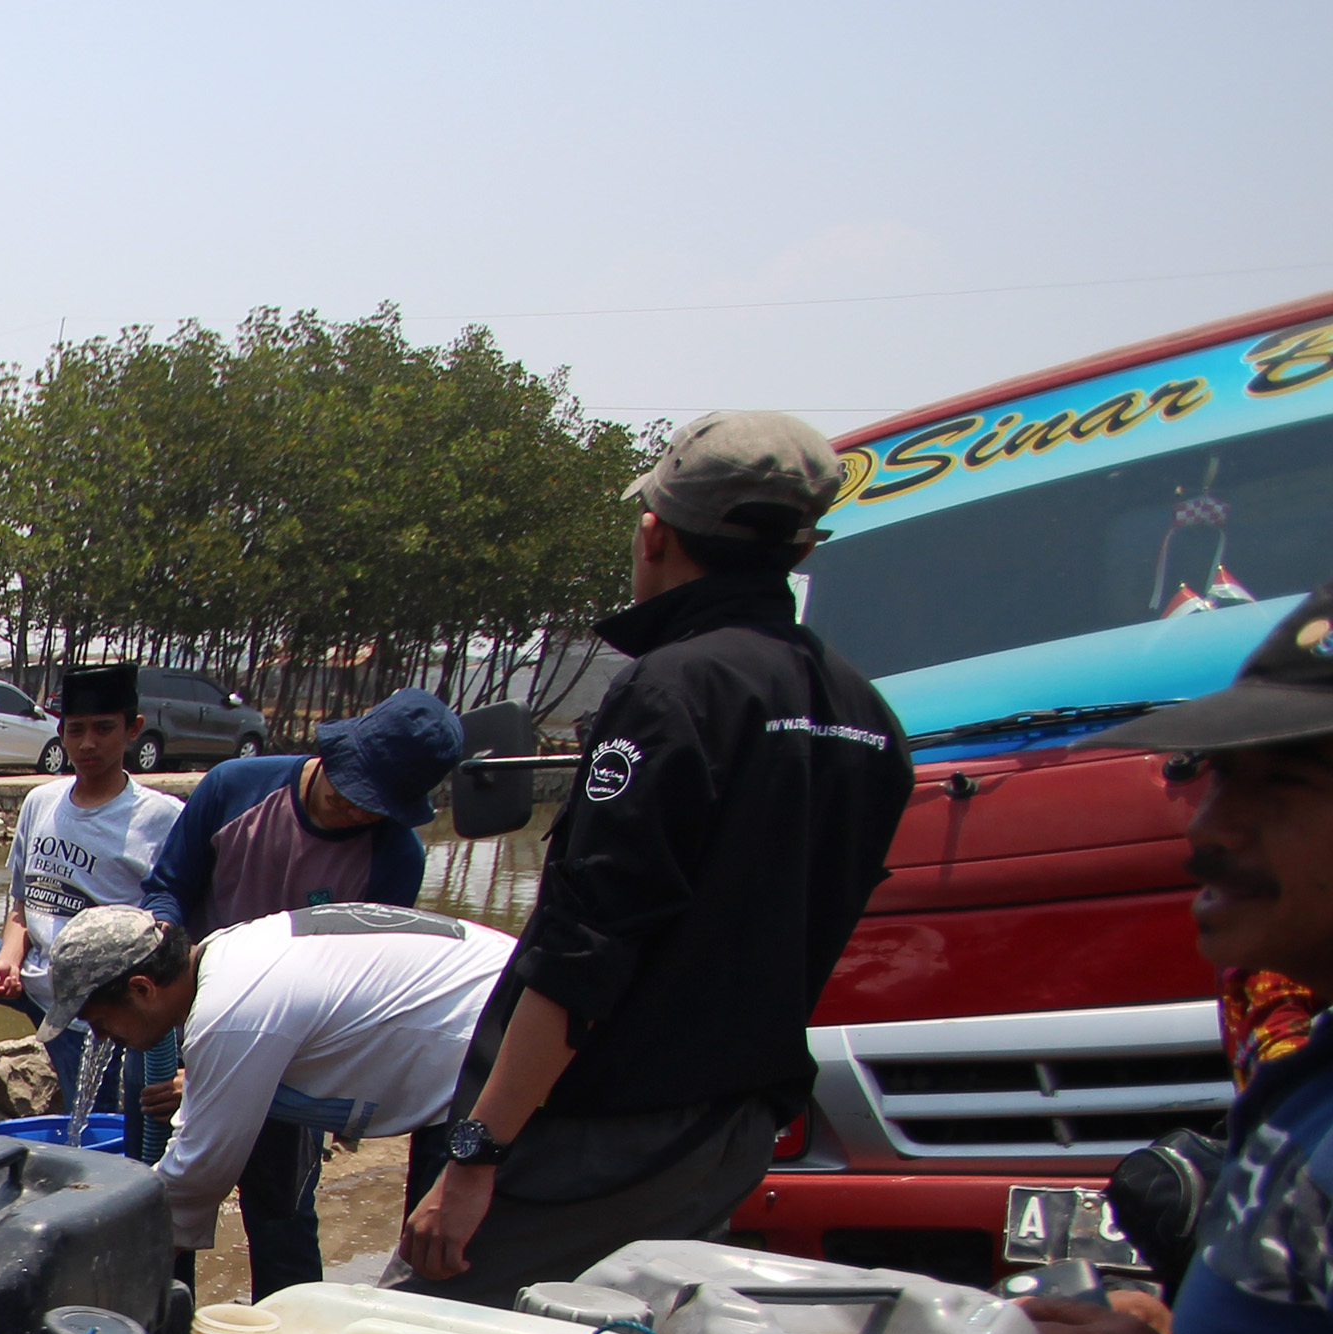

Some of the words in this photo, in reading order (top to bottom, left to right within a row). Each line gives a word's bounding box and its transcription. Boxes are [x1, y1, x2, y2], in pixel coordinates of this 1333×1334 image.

[857, 377, 1212, 506] Sinar
[591, 738, 643, 763] RELAWAN
[31, 837, 97, 875] BONDI
[34, 857, 75, 879] BEACH
[28, 887, 57, 902] SOUTH
[56, 895, 83, 910] WALES
[1018, 1196, 1046, 1239] A
